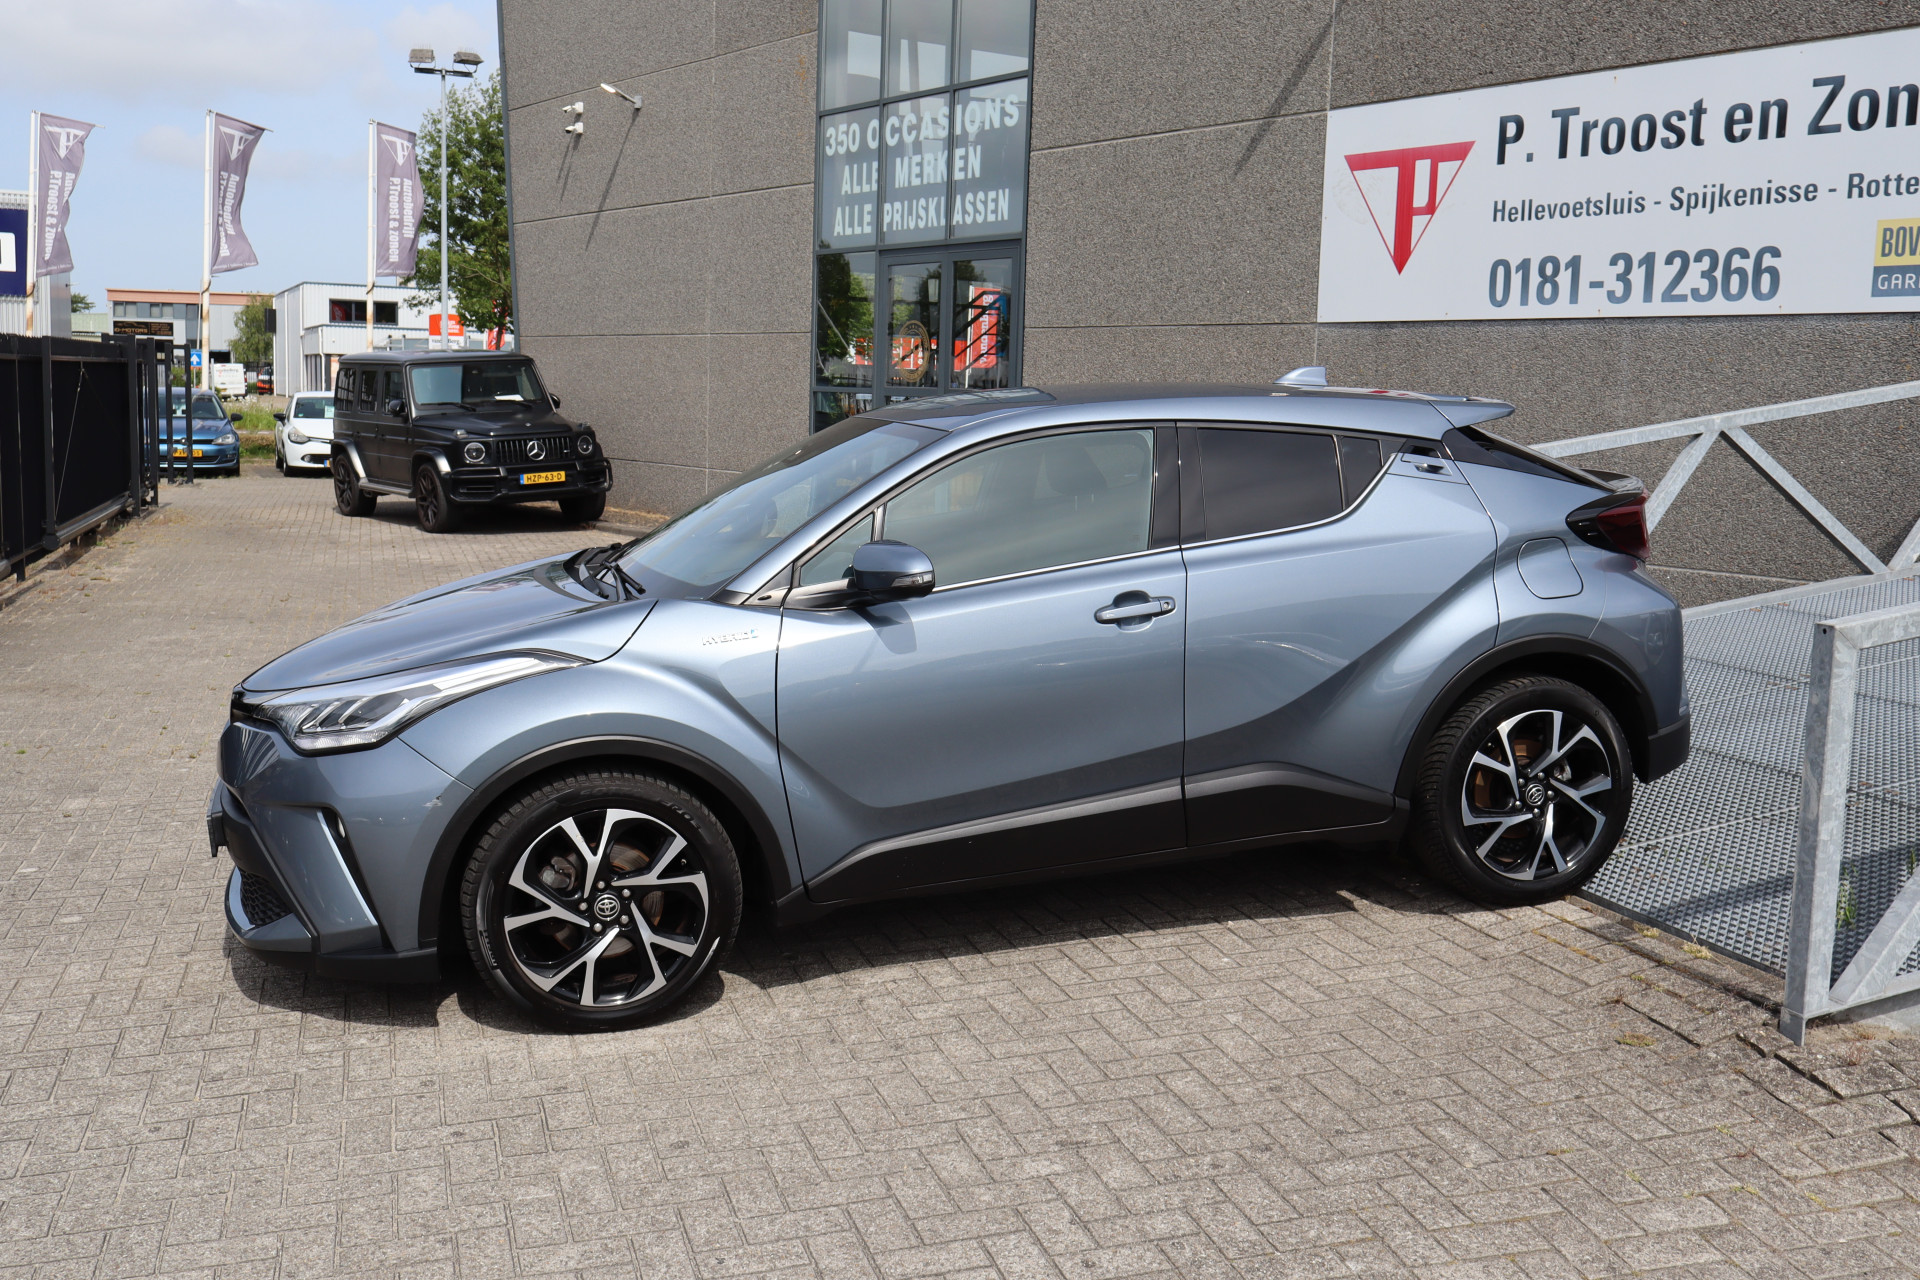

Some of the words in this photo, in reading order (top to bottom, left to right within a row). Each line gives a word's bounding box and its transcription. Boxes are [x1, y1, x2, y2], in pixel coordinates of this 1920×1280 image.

[825, 122, 860, 156] 350
[867, 94, 1020, 149] OCCASIONS
[1496, 114, 1534, 165] P.
[1551, 97, 1708, 159] Troost
[1724, 98, 1789, 143] en
[1807, 75, 1920, 135] Zon
[841, 161, 878, 195] ALLE
[895, 145, 981, 188] MERKEN
[389, 177, 401, 219] P.Troost
[402, 178, 415, 239] Autobedrijf
[834, 203, 873, 236] ALLE
[883, 188, 1009, 232] PRIJSKLASSEN
[1493, 190, 1646, 222] Hellevoetsluis
[1669, 179, 1818, 216] Spijkenisse
[1847, 172, 1920, 199] Rotte
[389, 220, 399, 228] &
[389, 230, 399, 262] zonen
[1880, 225, 1920, 258] BOV
[1488, 245, 1782, 308] 0181-312366
[1877, 273, 1920, 290] GAR
[526, 473, 563, 483] HZP-63-D
